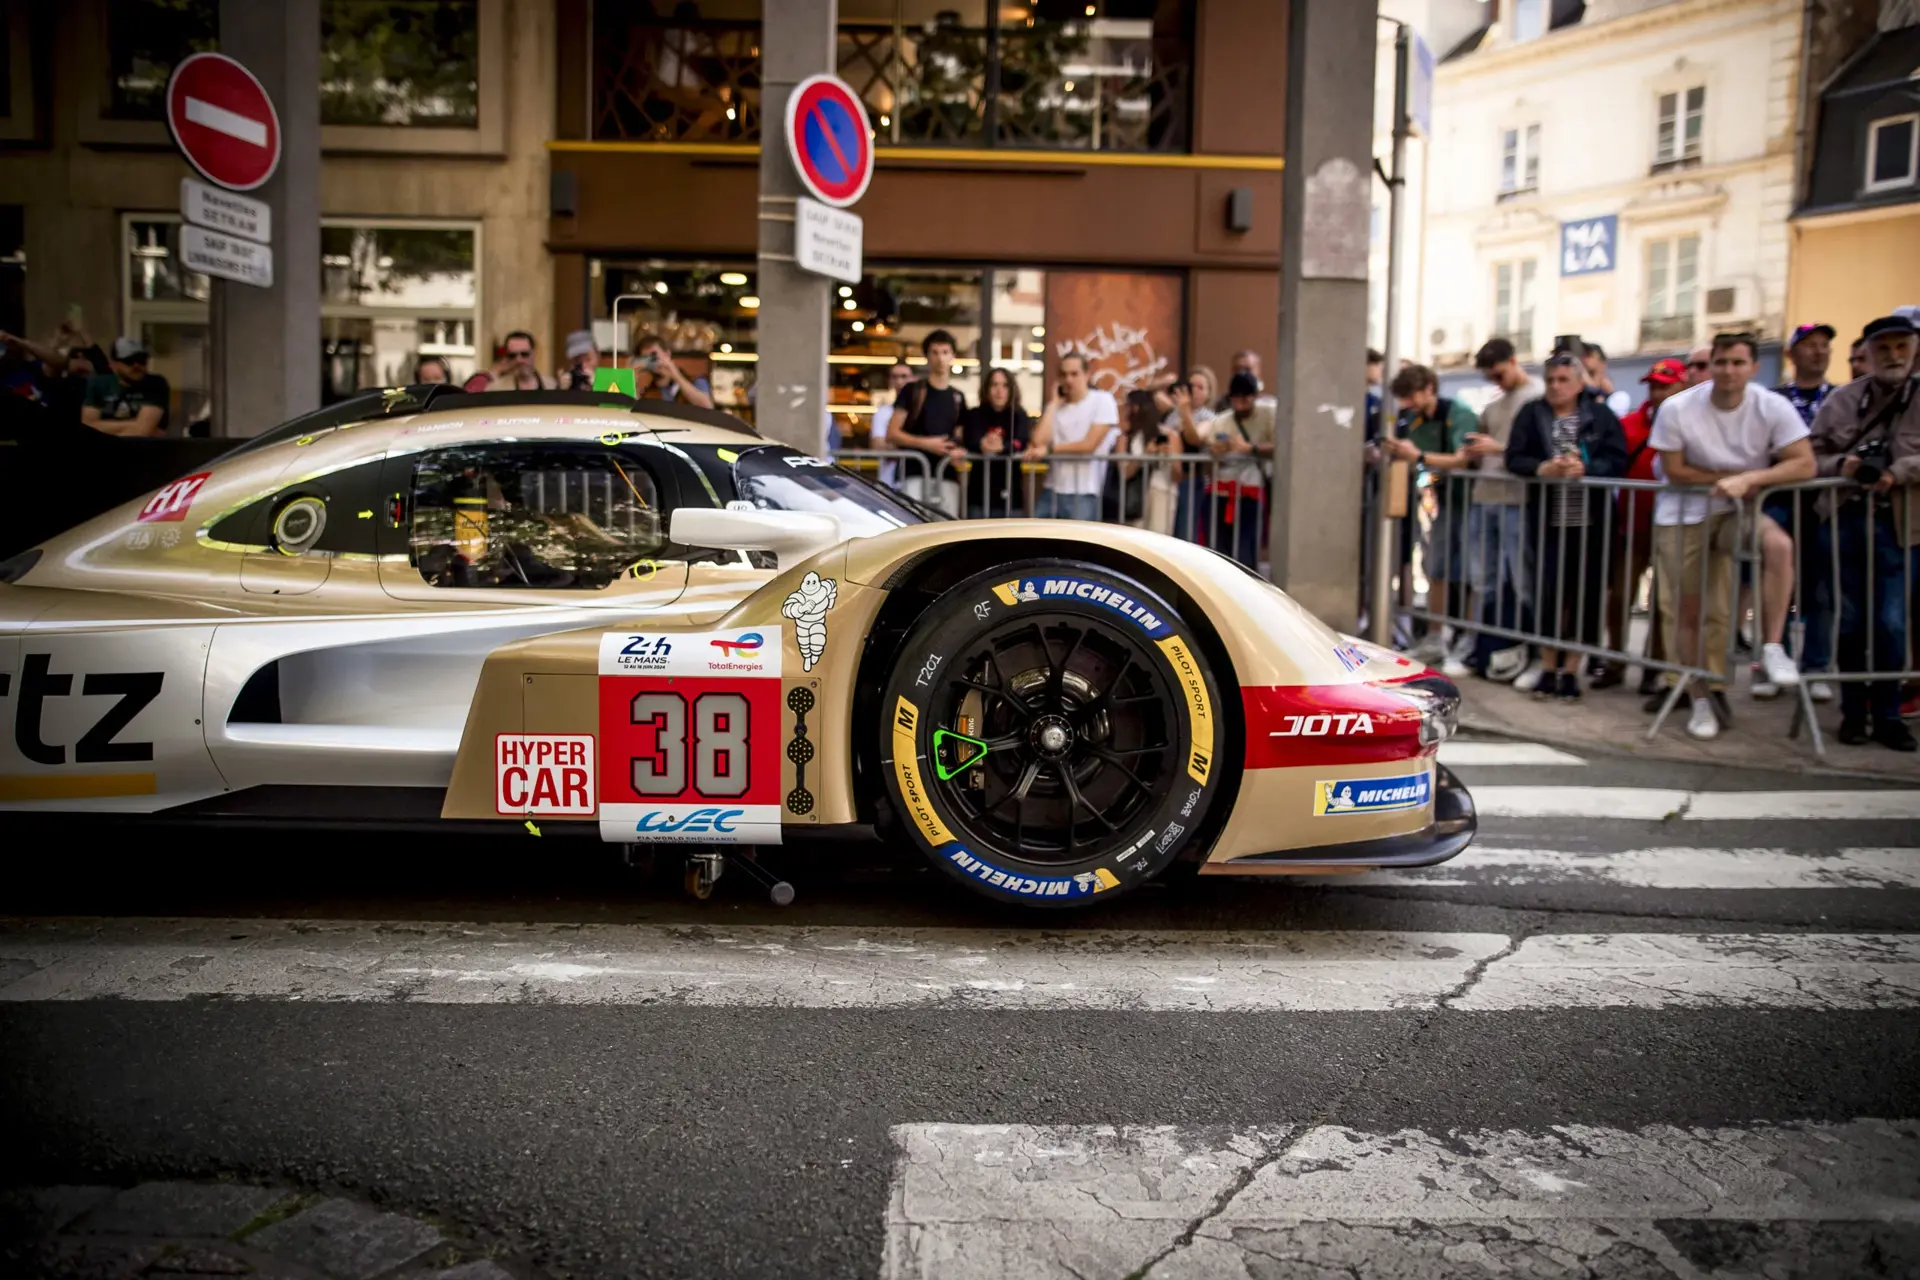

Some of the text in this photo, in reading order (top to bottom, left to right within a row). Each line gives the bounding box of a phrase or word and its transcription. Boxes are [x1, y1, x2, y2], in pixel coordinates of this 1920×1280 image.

[417, 421, 463, 433] HANSON
[496, 417, 541, 425] BUTTON
[144, 479, 204, 514] HY
[973, 600, 992, 621] RF
[1043, 580, 1162, 631] MICHELIN
[707, 662, 764, 672] TotalEnergies
[915, 653, 942, 687] T201
[1170, 645, 1206, 719] PILOT SPORT
[0, 653, 165, 765] tz
[897, 706, 915, 731] M
[1269, 713, 1374, 737] JOTA
[502, 741, 586, 765] HYPER
[630, 691, 751, 798] 38
[1191, 752, 1209, 776] M
[502, 767, 589, 807] CAR
[1357, 783, 1427, 803] MICHELIN
[902, 763, 941, 837] PILOT SPORT
[635, 808, 744, 832] WEC
[950, 850, 1070, 895] MICHELIN
